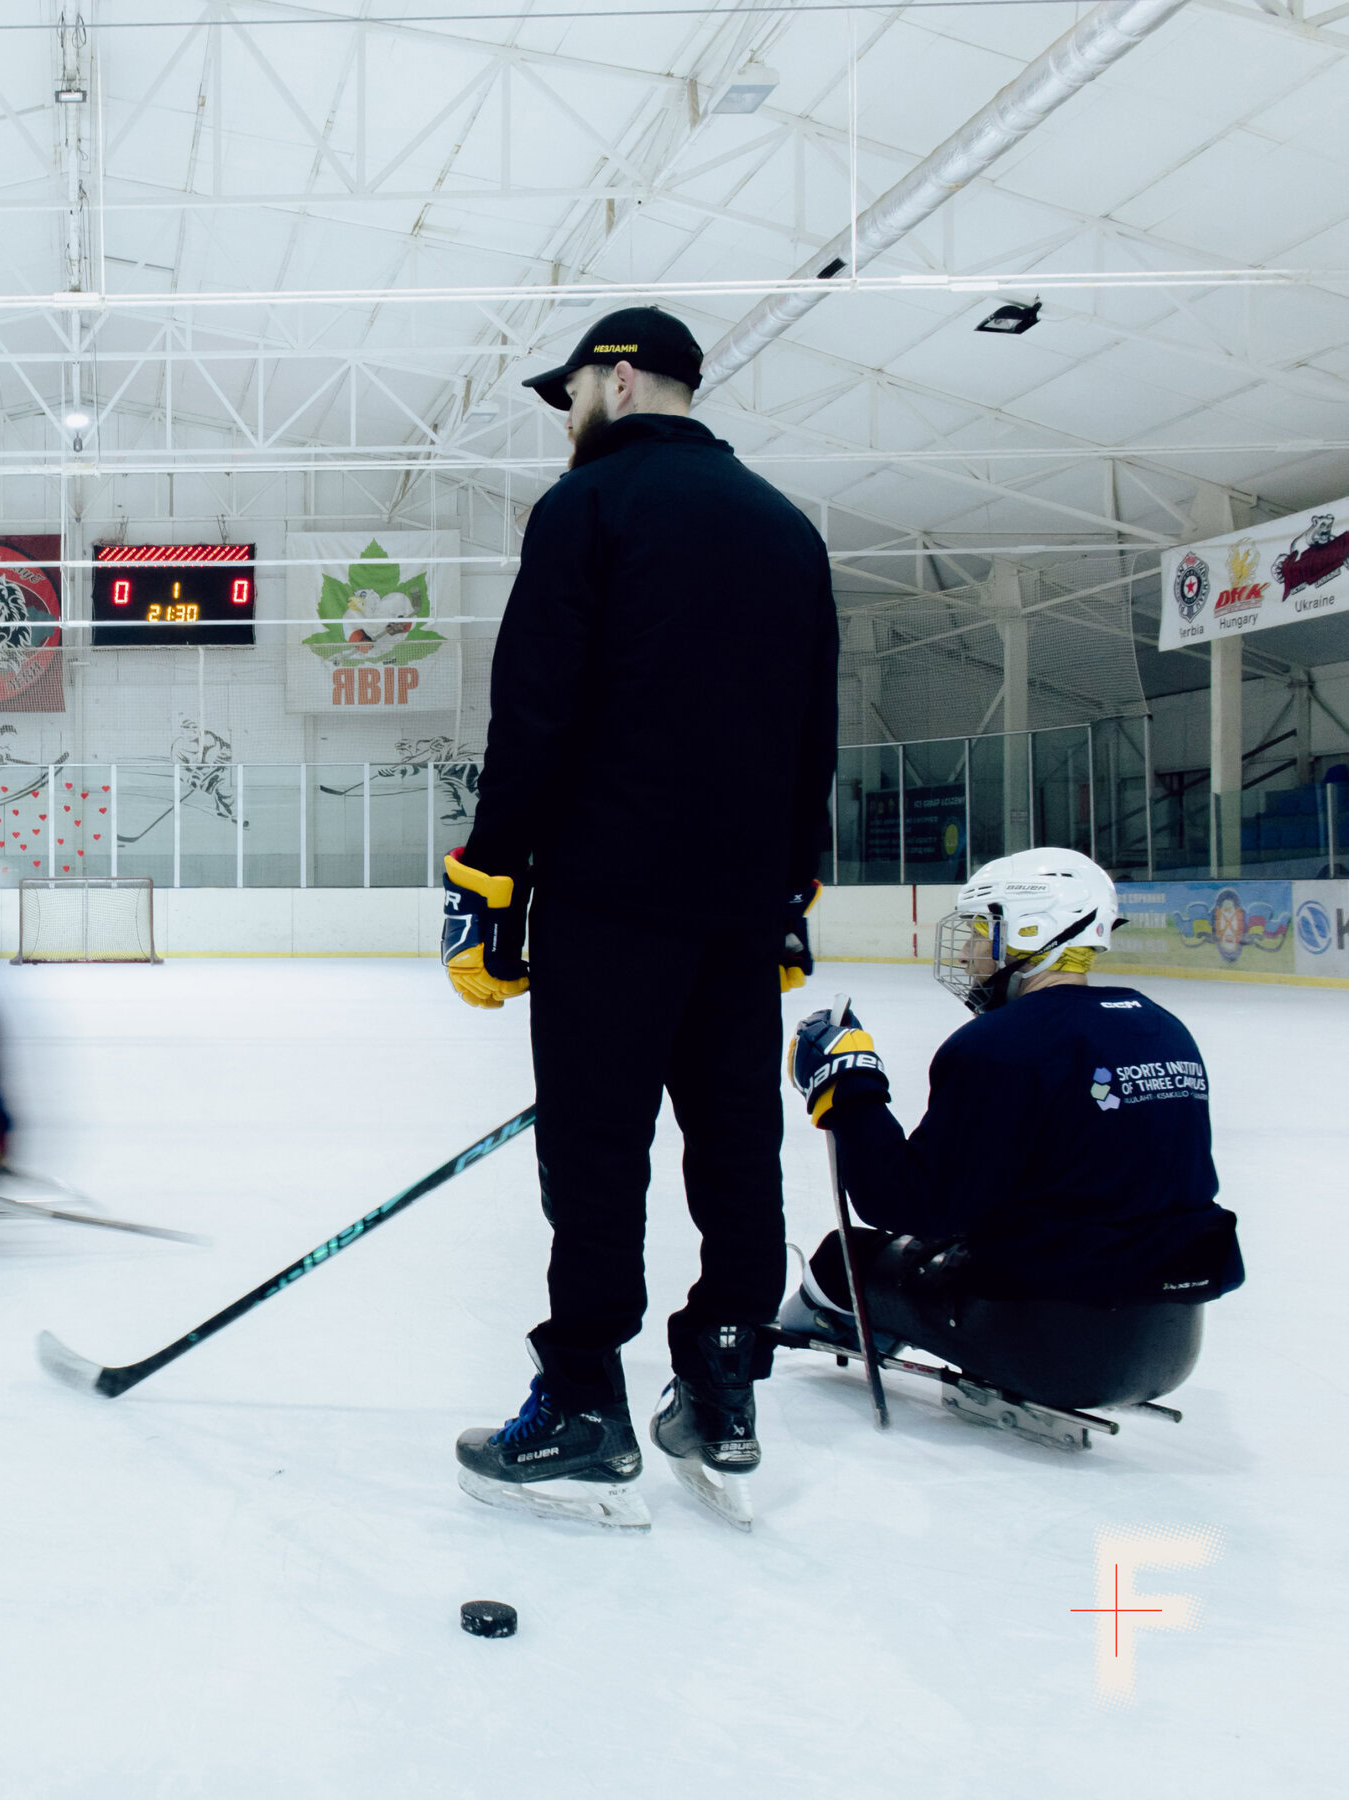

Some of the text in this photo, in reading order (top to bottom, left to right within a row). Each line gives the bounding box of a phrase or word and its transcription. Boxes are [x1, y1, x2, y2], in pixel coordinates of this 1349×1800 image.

[593, 344, 638, 353] НЕЗЛАМНІ
[113, 580, 130, 604] 0
[172, 581, 181, 600] 1
[232, 579, 249, 603] 0
[1215, 582, 1270, 610] DHK
[1294, 594, 1336, 613] Ukraine
[148, 604, 199, 623] 21:30
[1219, 612, 1259, 631] Hungary
[332, 666, 419, 705] ЯВІР
[1100, 1000, 1142, 1009] CCM
[1116, 1062, 1165, 1082] SPORTS
[1121, 1081, 1134, 1096] OF
[1135, 1077, 1175, 1093] THREE
[516, 1446, 560, 1463] BAUER
[720, 1442, 758, 1451] BAUER
